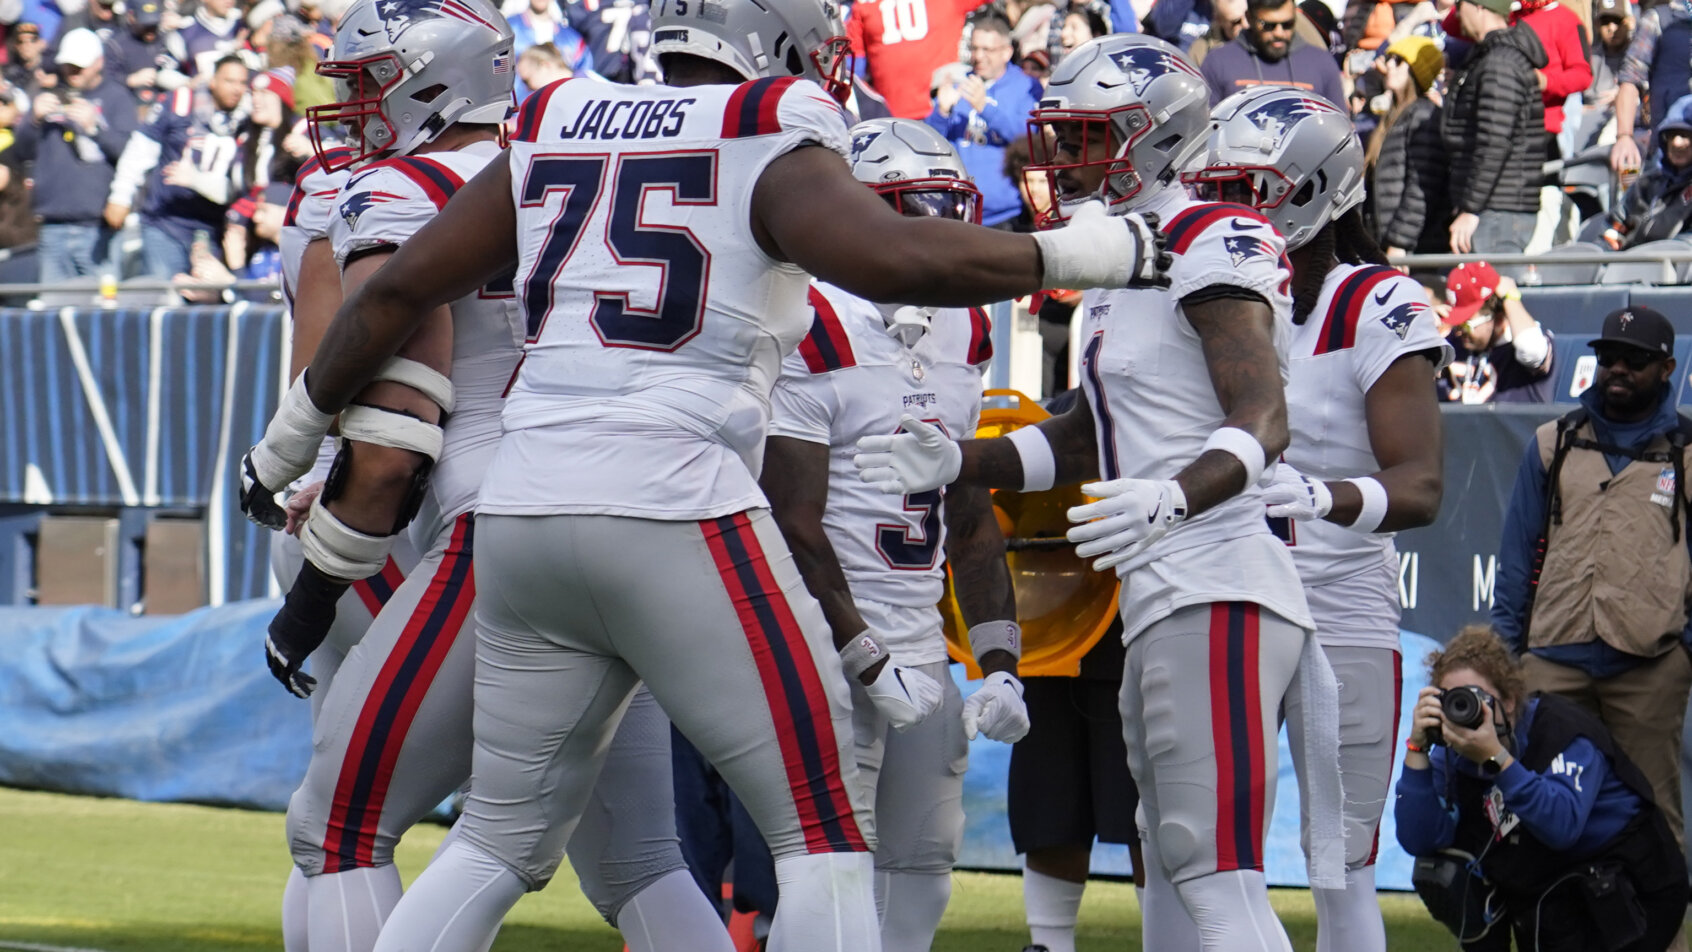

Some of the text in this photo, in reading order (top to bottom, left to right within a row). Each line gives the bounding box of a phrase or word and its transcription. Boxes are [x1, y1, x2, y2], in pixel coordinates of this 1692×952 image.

[879, 0, 928, 45] 10
[560, 98, 697, 140] JACOBS
[520, 148, 719, 353] 75
[902, 392, 936, 407] PATRIOTS
